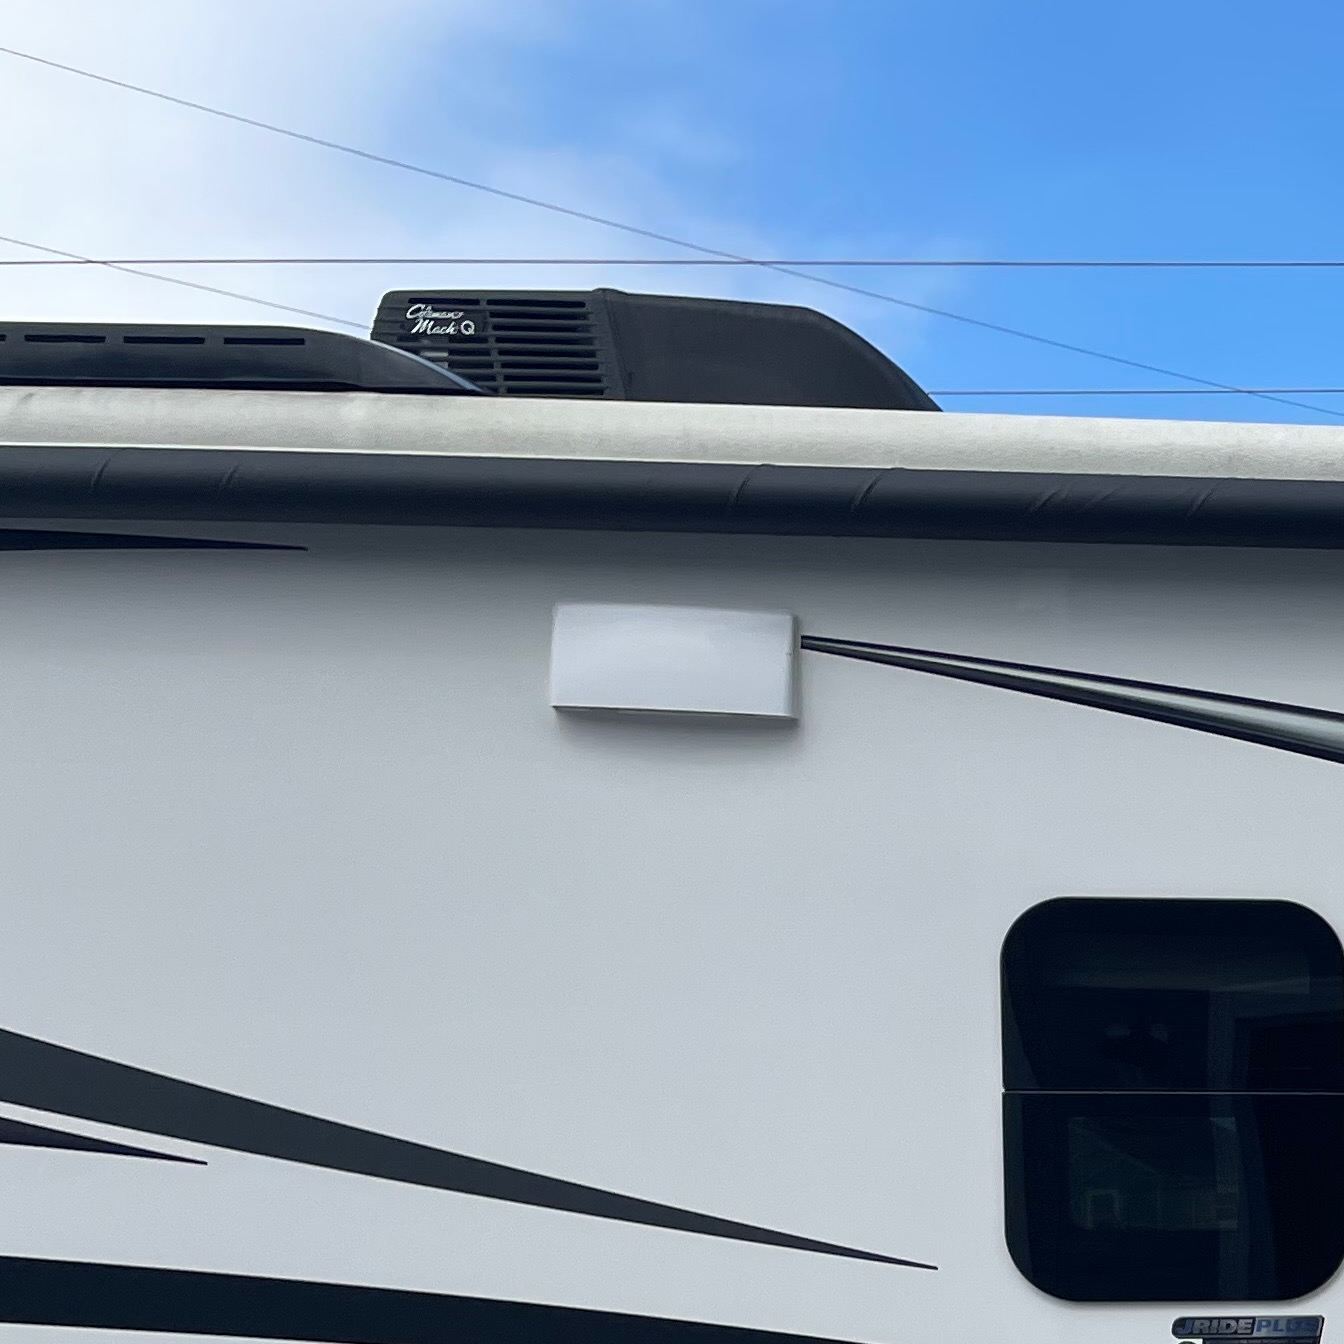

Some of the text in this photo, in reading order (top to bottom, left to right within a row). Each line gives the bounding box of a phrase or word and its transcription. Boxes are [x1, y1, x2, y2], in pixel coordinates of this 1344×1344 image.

[411, 319, 475, 335] Mach Q
[1176, 1318, 1253, 1335] JRIDE
